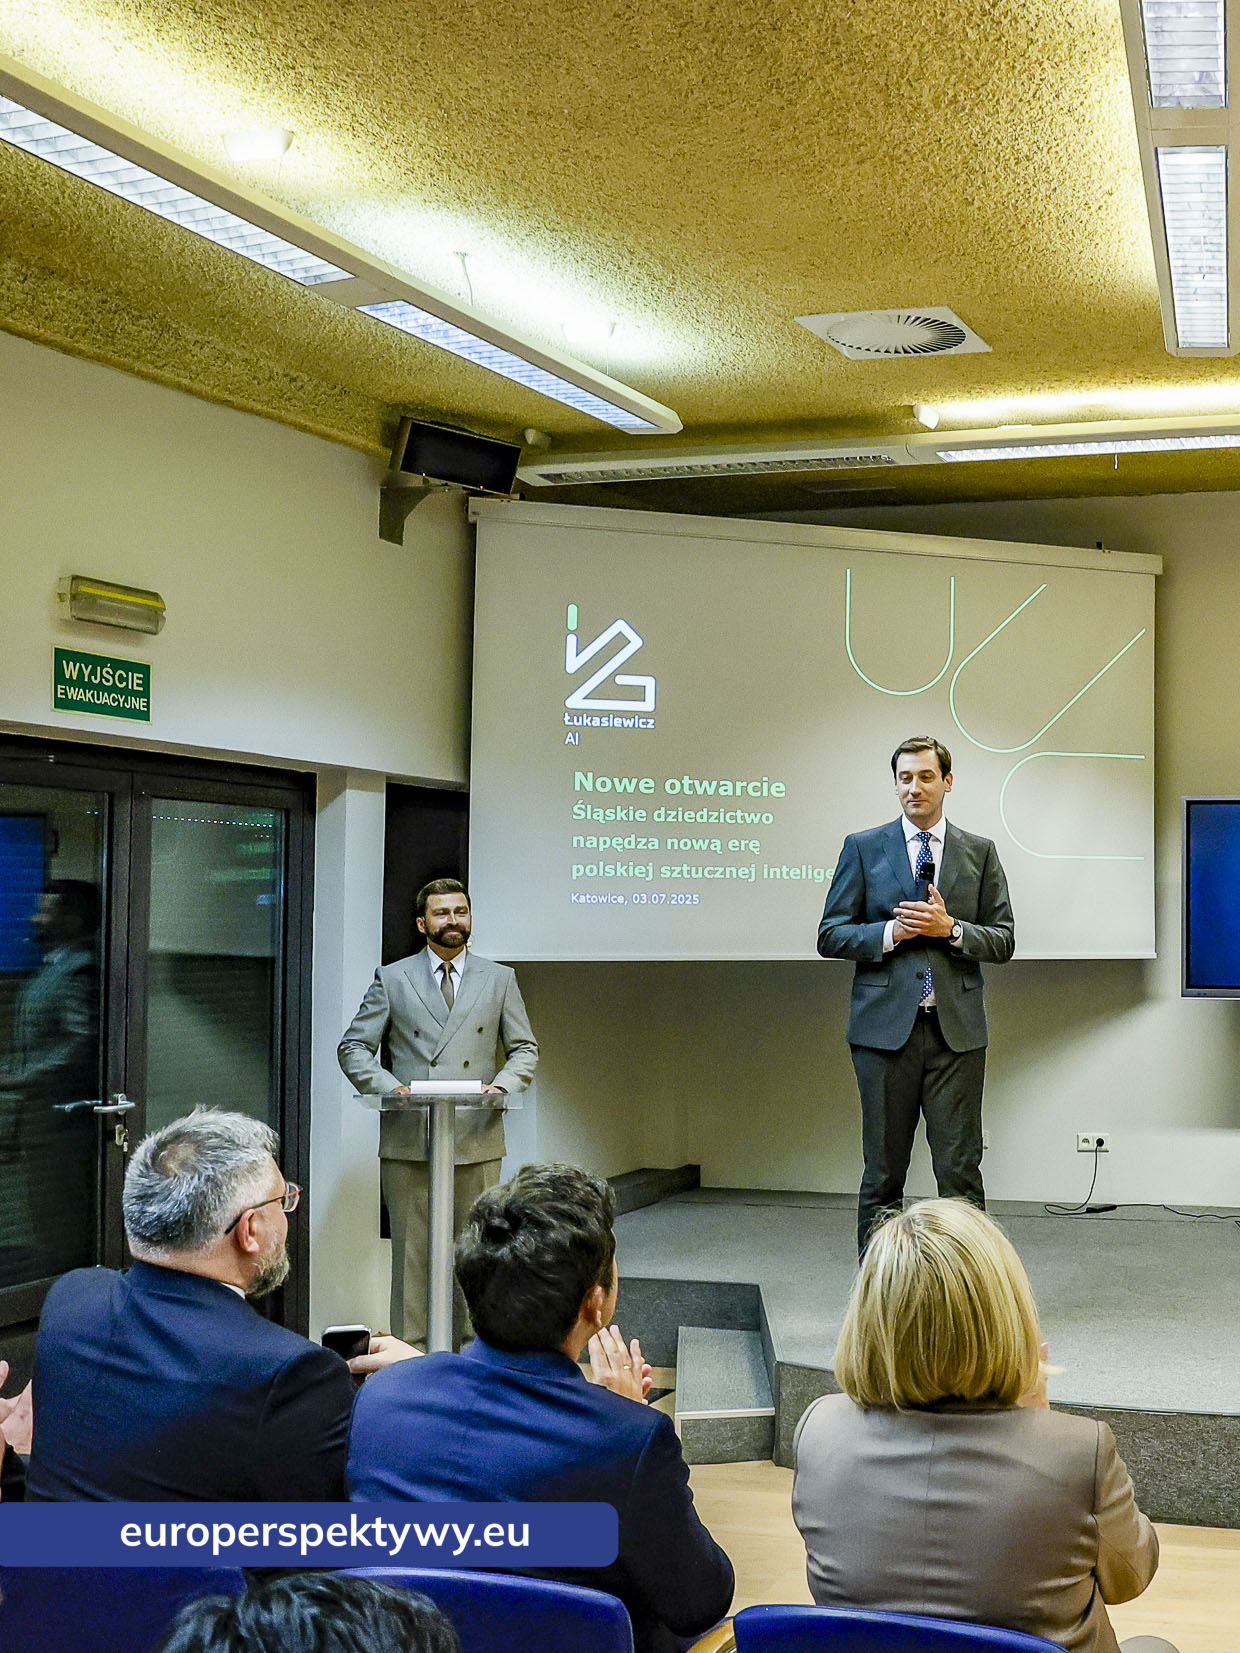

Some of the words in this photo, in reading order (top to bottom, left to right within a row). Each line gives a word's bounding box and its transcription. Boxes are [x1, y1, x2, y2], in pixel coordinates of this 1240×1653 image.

[62, 660, 144, 691] WYJŚCIE
[57, 685, 148, 711] EWAKUACYJNE
[564, 712, 655, 729] Łukasiewicz
[565, 732, 580, 745] AI
[573, 772, 655, 793] Nowe
[664, 776, 786, 798] otwarcie
[572, 800, 647, 823] Śląskie
[653, 807, 774, 825] dziedzictwo
[572, 834, 659, 851] napędza
[667, 836, 723, 854] nową
[728, 839, 760, 854] erę
[572, 862, 653, 880] polskiej
[660, 864, 756, 882] sztucznej
[571, 893, 628, 905] Katowice,
[632, 893, 700, 905] 03.07.2025
